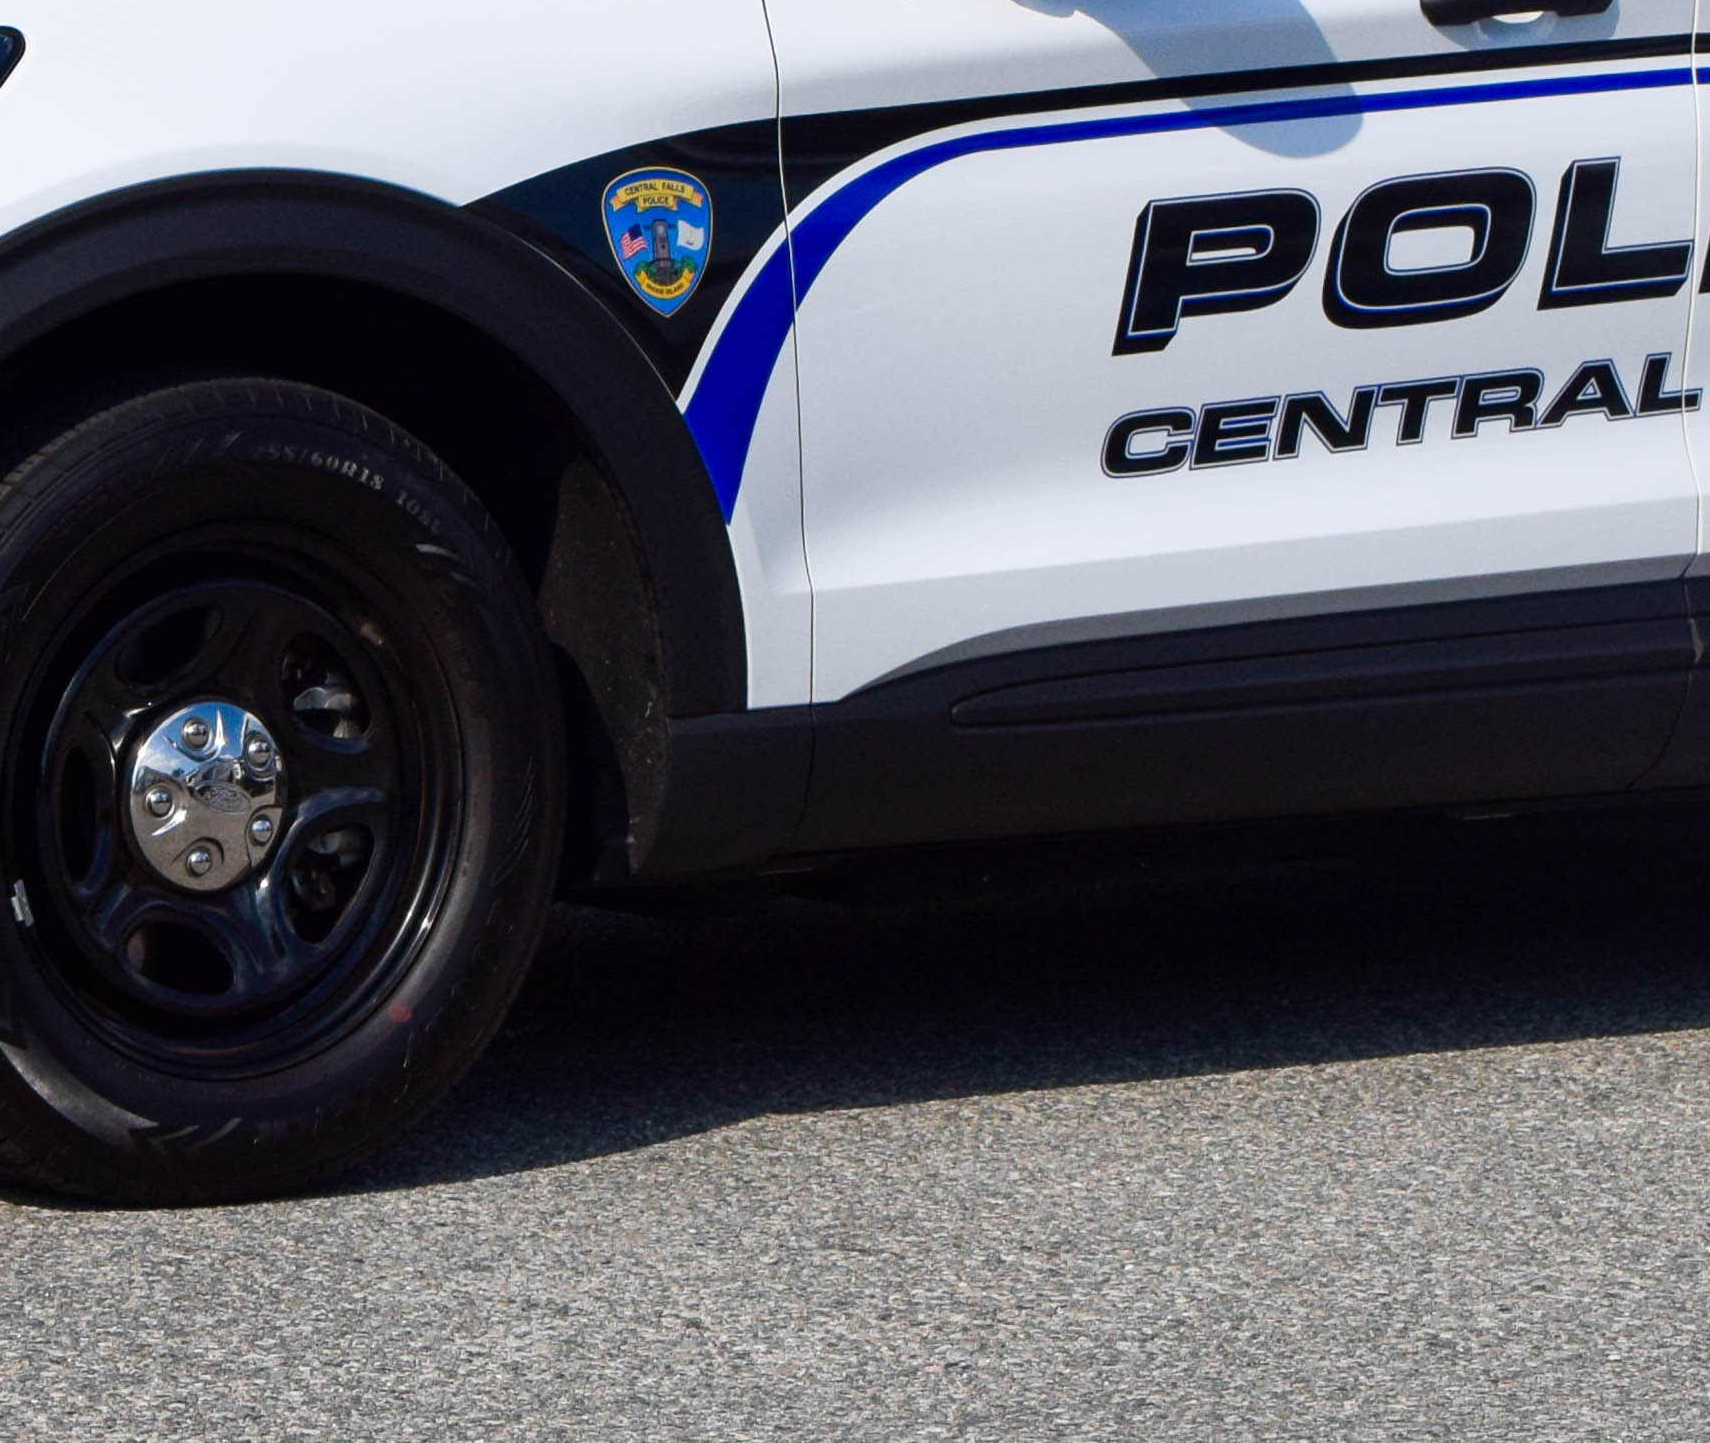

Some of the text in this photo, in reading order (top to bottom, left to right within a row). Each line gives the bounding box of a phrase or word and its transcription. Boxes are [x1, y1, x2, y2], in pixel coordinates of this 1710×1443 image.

[624, 181, 686, 196] CENTRAL FALLS
[642, 196, 669, 206] POLICE
[1100, 353, 1702, 480] CENTRAL
